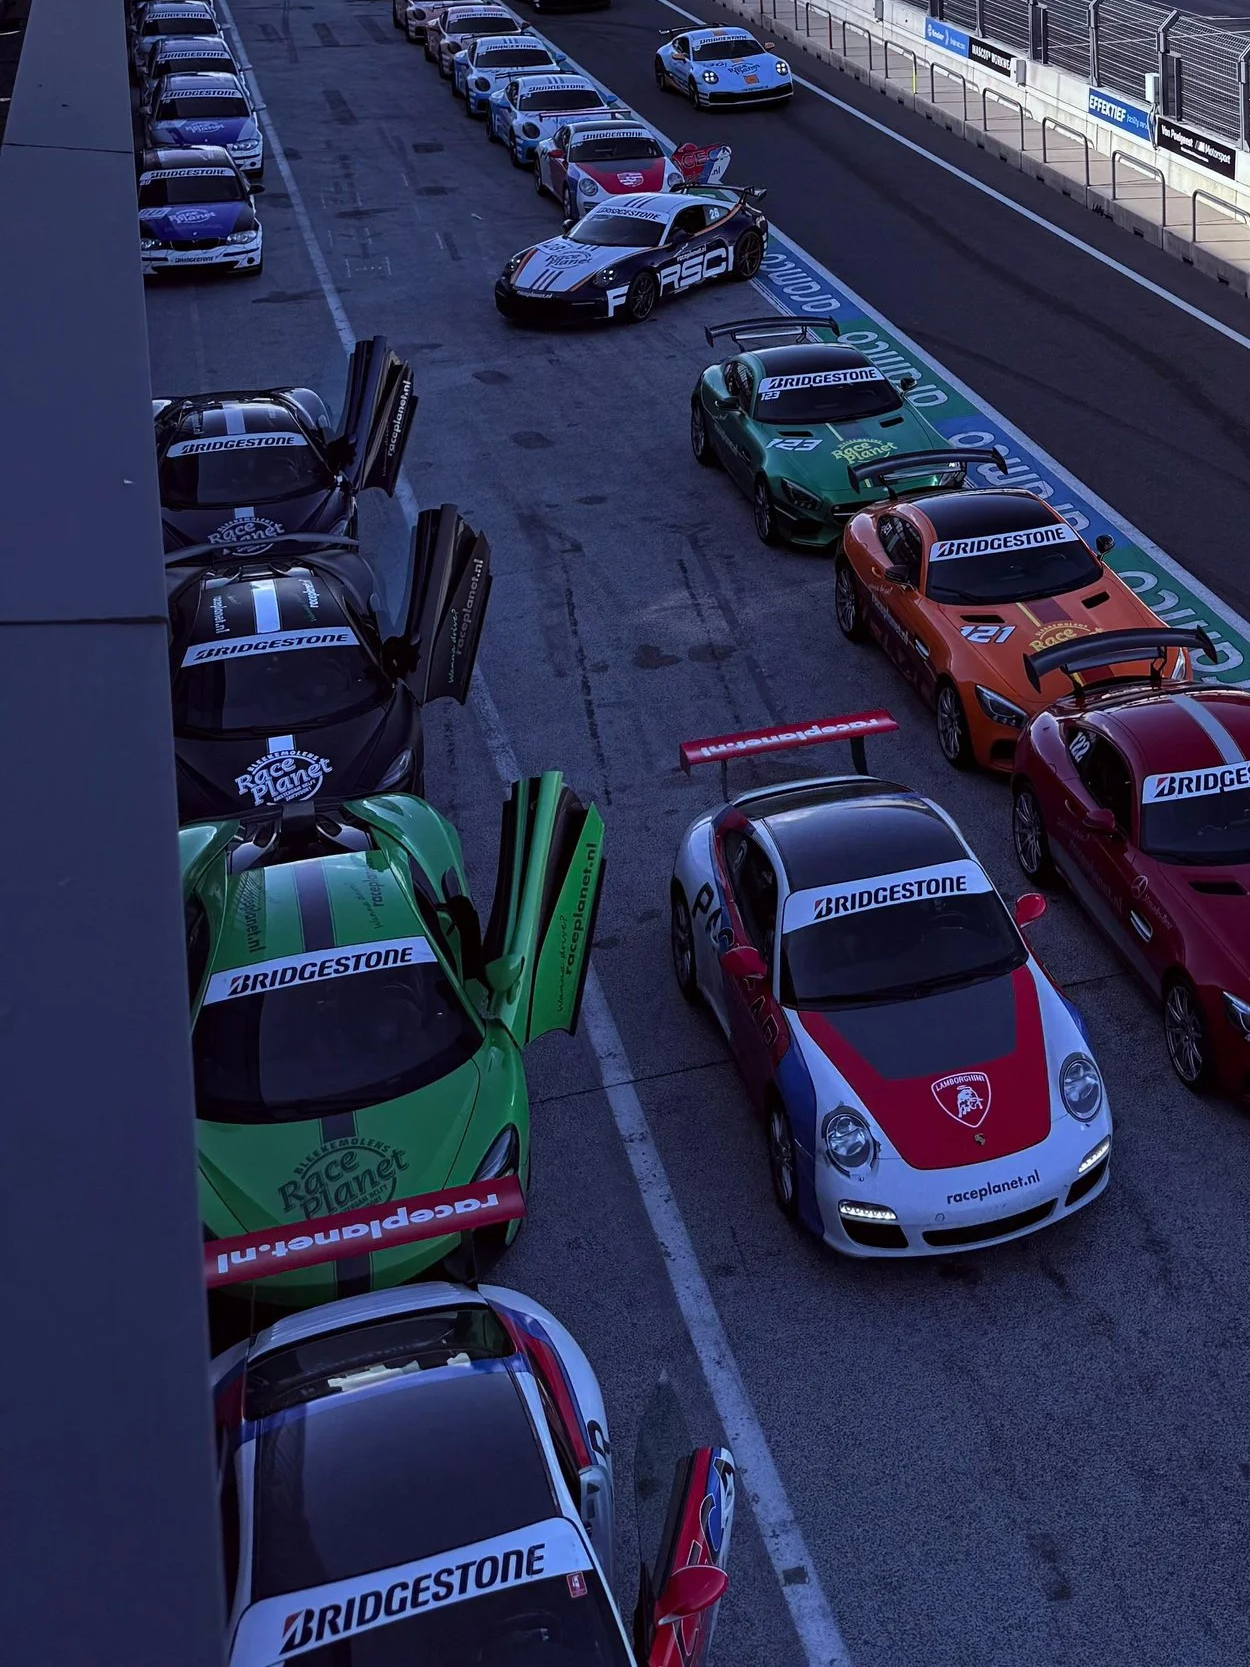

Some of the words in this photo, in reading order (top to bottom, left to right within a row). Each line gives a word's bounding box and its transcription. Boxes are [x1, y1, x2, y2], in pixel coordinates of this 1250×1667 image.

[165, 89, 238, 98] BRIDGESTONE
[1089, 95, 1127, 123] EFFEKTIEF
[151, 169, 226, 178] BRIDGESTONE
[759, 253, 841, 313] aramco
[768, 368, 877, 390] BRIDGESTONE
[837, 331, 949, 408] aramco
[759, 390, 781, 402] 123
[387, 379, 411, 457] raceplanet.nl
[181, 436, 296, 455] BRIDGESTONE
[767, 438, 823, 452] 123
[831, 442, 872, 461] Race
[843, 440, 899, 465] Planet
[208, 522, 257, 544] Race
[935, 526, 1066, 558] BRIDGESTONE
[457, 557, 483, 655] raceplanet.nl
[193, 633, 349, 661] BRIDGESTONE
[959, 624, 1017, 645] 121
[1028, 628, 1078, 653] Race
[700, 717, 880, 757] raceplanet.nl
[1068, 730, 1092, 765] 122
[235, 758, 297, 795] Race
[246, 750, 320, 772] BLEEKEMOLENS
[250, 757, 334, 807] Planet
[565, 841, 598, 976] raceplanet.nl
[813, 874, 968, 920] BRIDGESTONE
[559, 914, 568, 960] drive?
[227, 947, 414, 997] BRIDGESTONE
[556, 962, 567, 1014] Wanna
[935, 1074, 986, 1092] LAMBORGHINI
[293, 1136, 393, 1176] BLEEKEMOLENS
[277, 1149, 359, 1214] Race
[302, 1148, 410, 1220] Planet
[946, 1169, 1041, 1205] raceplanet.nl
[216, 1193, 499, 1274] raceplanet.nl
[279, 1542, 547, 1656] BRIDGESTONE
